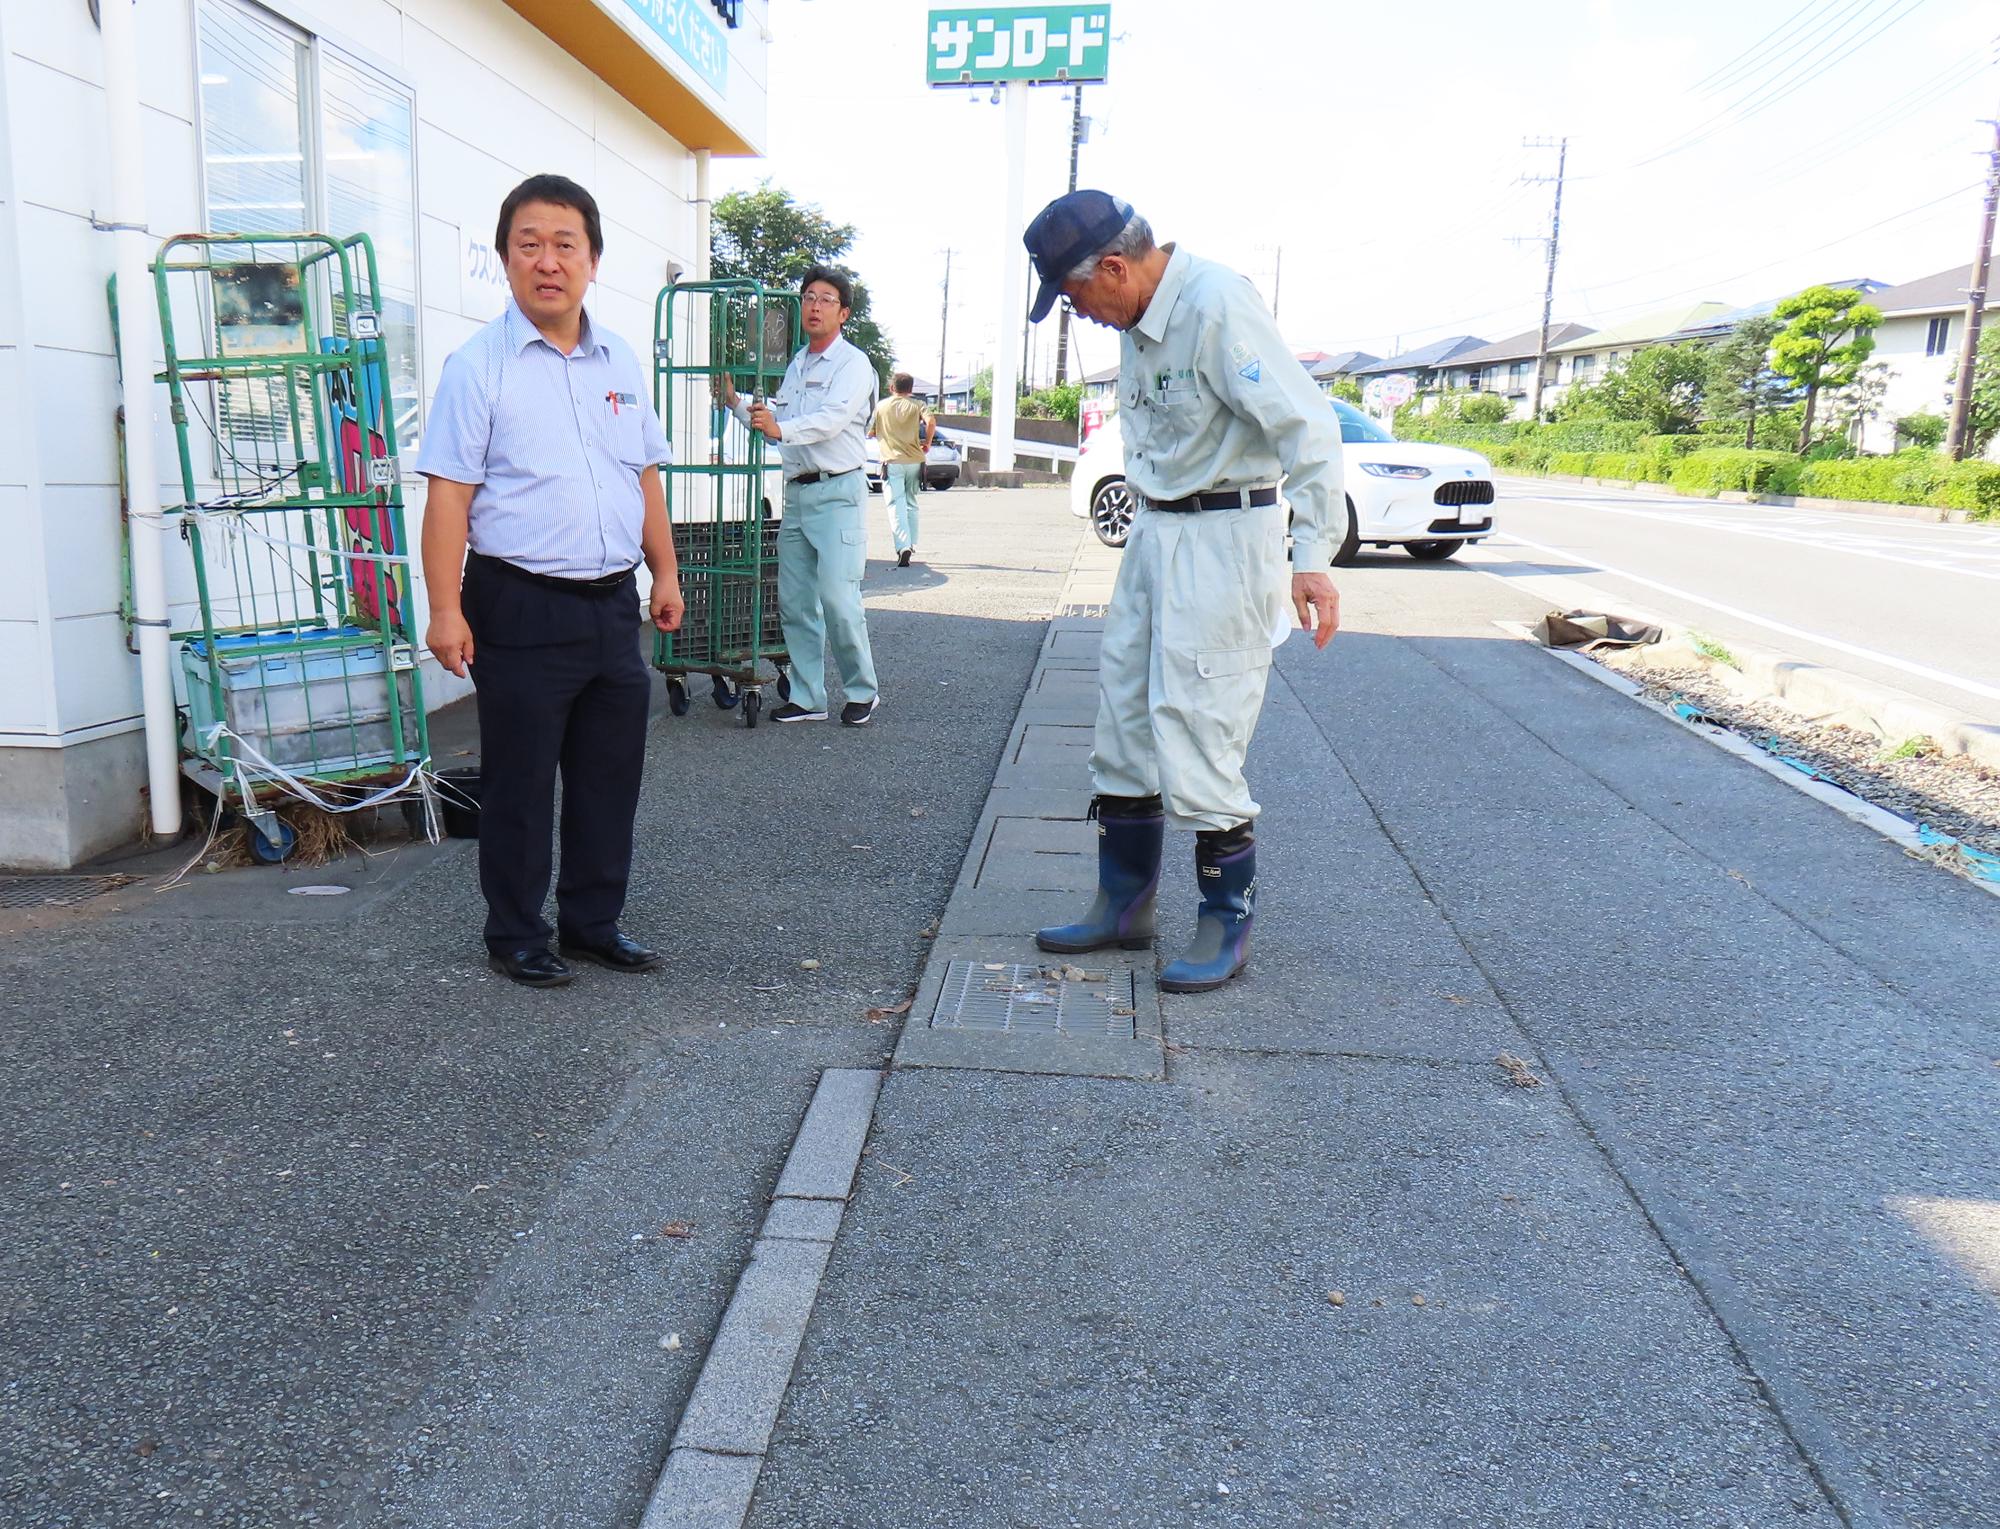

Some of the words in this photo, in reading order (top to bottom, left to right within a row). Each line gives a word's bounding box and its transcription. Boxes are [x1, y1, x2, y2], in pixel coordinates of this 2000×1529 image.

[931, 15, 1105, 69] サンロード
